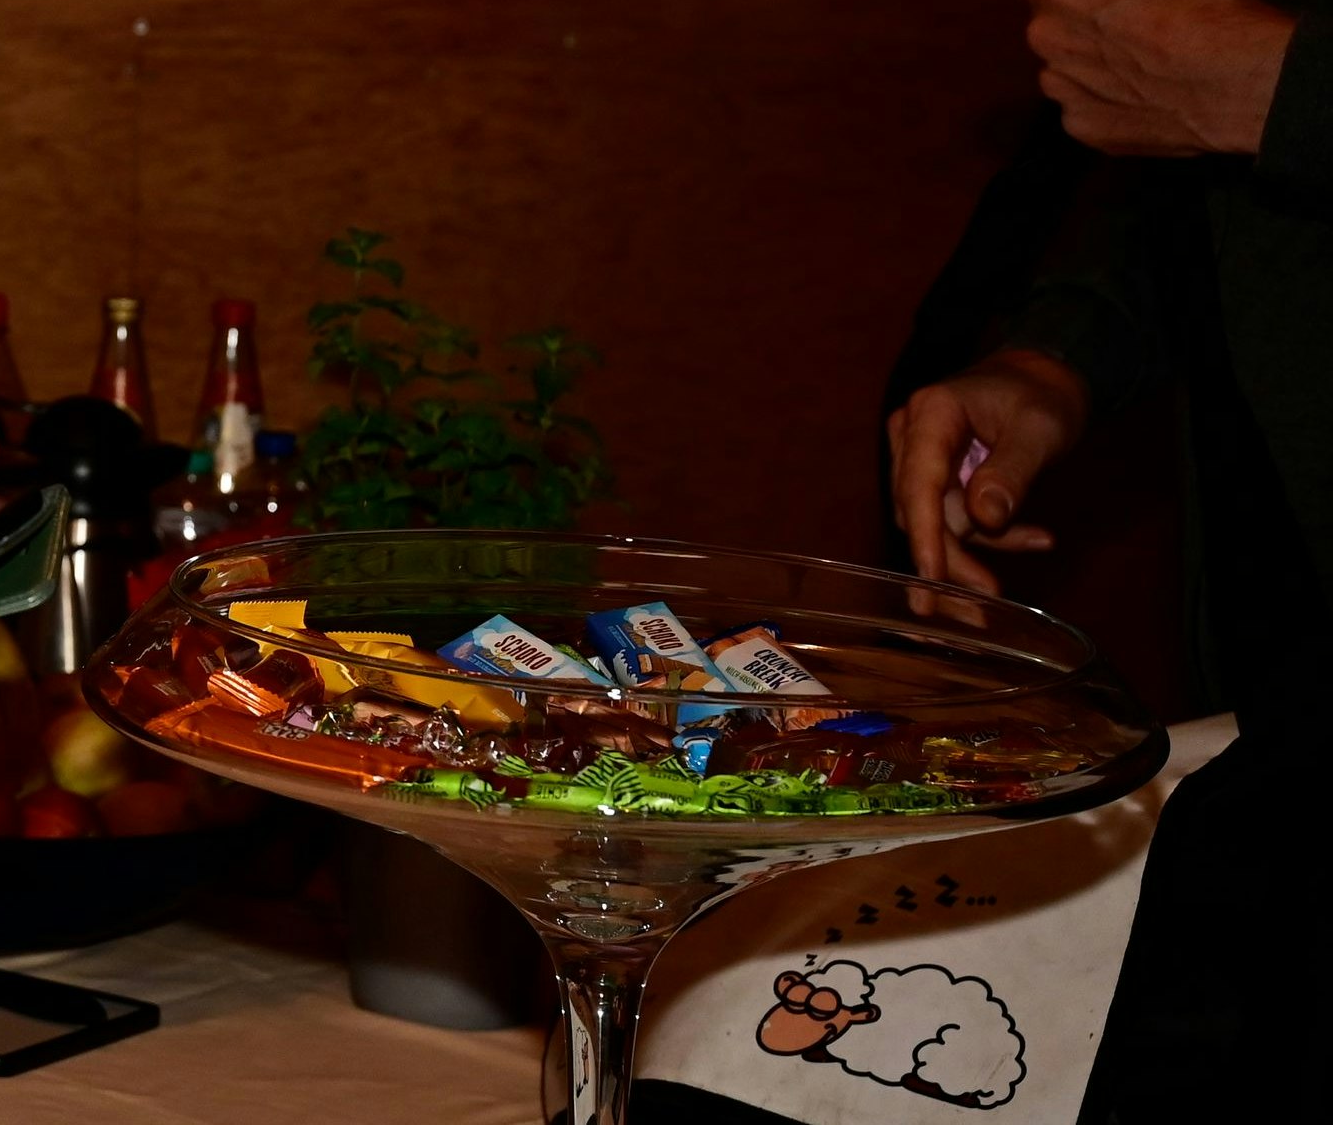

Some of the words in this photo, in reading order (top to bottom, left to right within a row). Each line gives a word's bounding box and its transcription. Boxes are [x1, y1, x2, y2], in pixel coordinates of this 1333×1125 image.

[639, 618, 684, 651] SCHOKO
[494, 634, 553, 671] SCHOKO
[754, 649, 815, 683] CRUNCHY
[743, 660, 789, 690] BREAK
